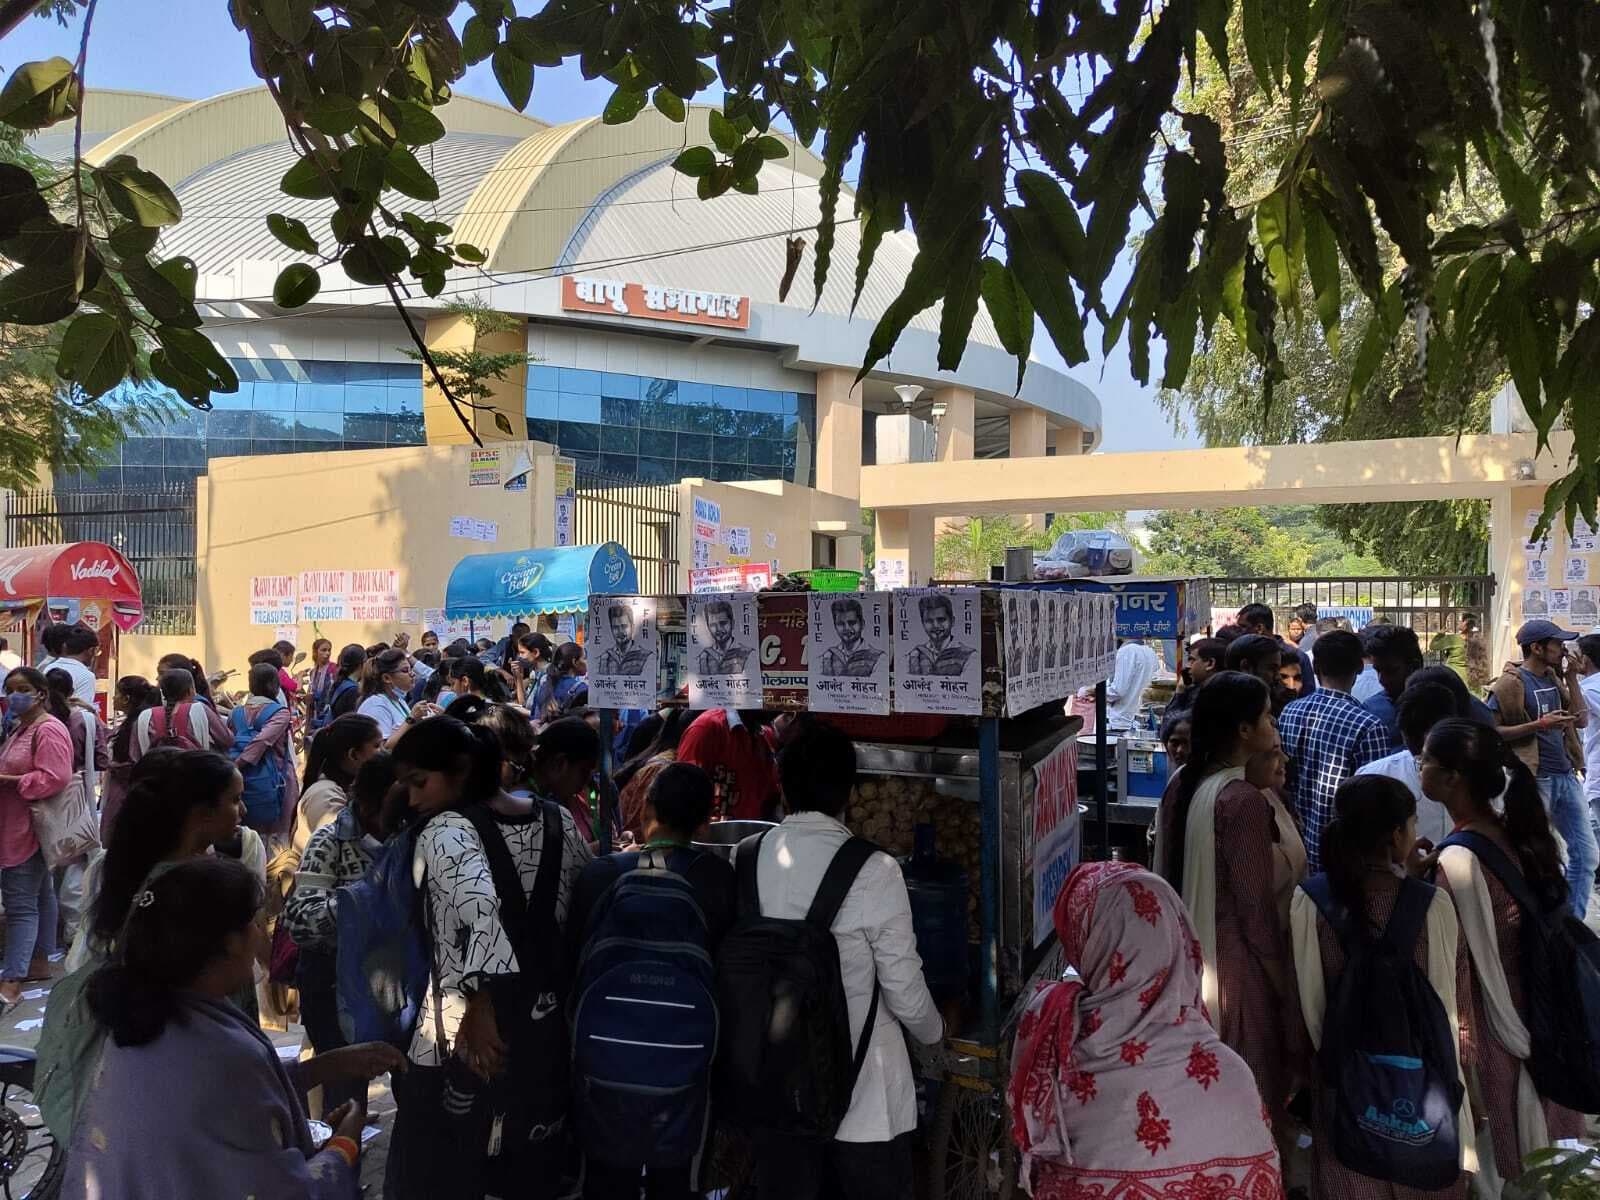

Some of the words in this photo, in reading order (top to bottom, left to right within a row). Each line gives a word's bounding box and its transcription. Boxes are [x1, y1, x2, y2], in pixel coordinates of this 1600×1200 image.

[574, 276, 629, 314] बापू
[643, 285, 741, 319] सभागार
[71, 557, 120, 586] Vadilal
[304, 572, 321, 592] RAVI
[322, 571, 344, 592] KANT
[352, 571, 370, 592] RAVI
[372, 570, 395, 592] KANT
[501, 566, 538, 585] Cream
[254, 578, 271, 597] RAVI
[272, 576, 293, 597] KANT
[508, 577, 529, 594] Bell
[254, 610, 292, 624] TREASURER
[304, 606, 343, 620] TREASURER
[353, 606, 394, 620] TREASURER
[743, 603, 751, 636] FOR
[813, 600, 823, 643] VOTE
[873, 603, 881, 638] FOR
[900, 599, 909, 641] VOTE
[965, 599, 973, 636] FOR
[760, 634, 786, 666] G.
[594, 676, 616, 690] आनंद
[623, 676, 647, 690] मोहन
[696, 677, 719, 689] आनंद
[726, 676, 750, 689] मोहन
[816, 678, 843, 692] आनंद
[851, 677, 878, 693] मोहन
[903, 677, 931, 692] आनंद
[940, 677, 969, 693] मोहन
